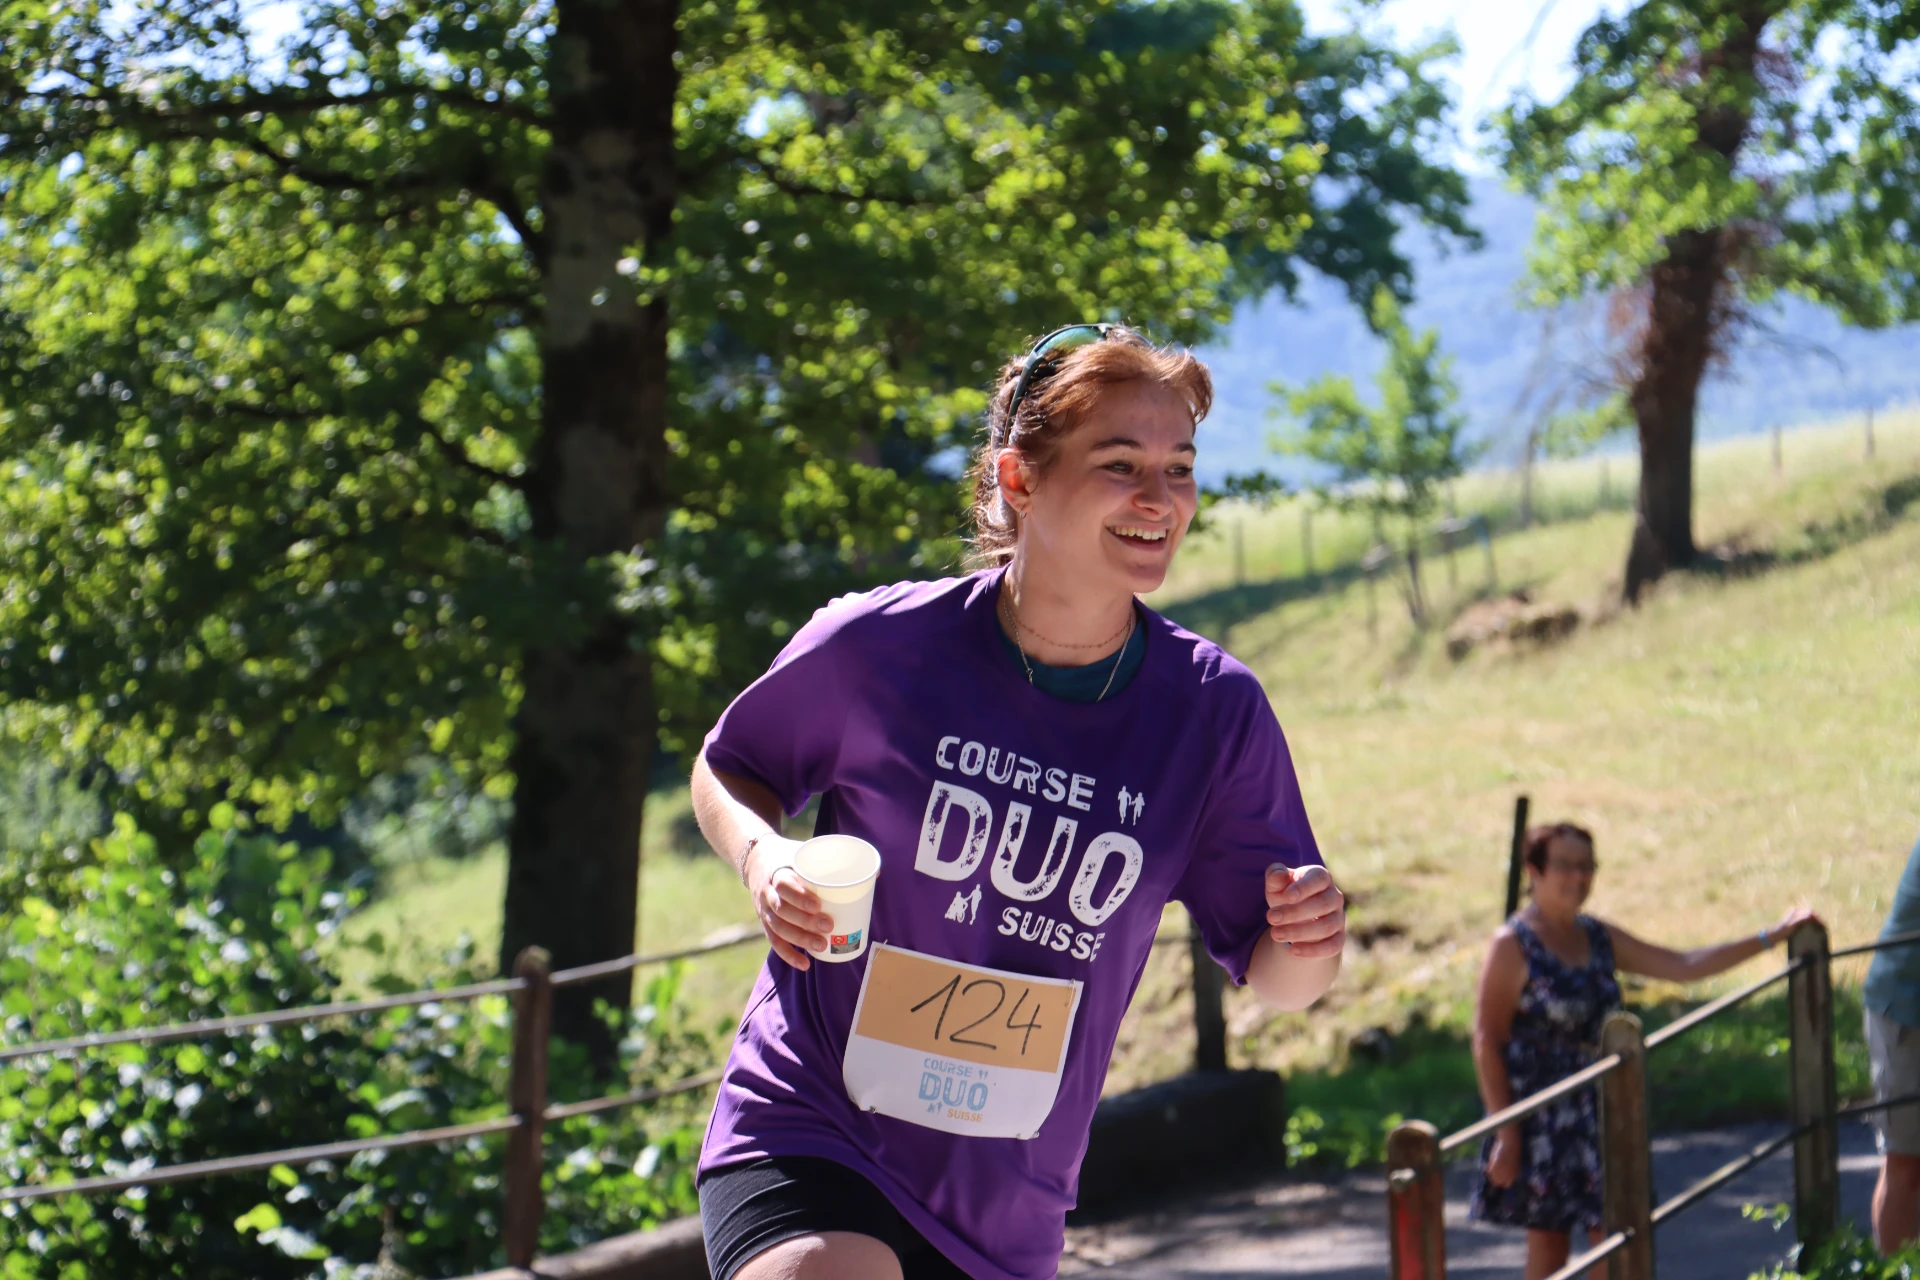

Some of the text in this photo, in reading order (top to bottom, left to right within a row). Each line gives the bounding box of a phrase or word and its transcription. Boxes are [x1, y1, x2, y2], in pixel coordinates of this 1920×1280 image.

[935, 735, 1096, 812] COURSE
[914, 779, 1144, 927] DUO
[997, 906, 1106, 963] SUISSE
[910, 974, 1042, 1056] 124
[918, 1071, 989, 1112] DUO
[923, 1057, 973, 1078] COURSE
[946, 1107, 984, 1123] SUISSE
